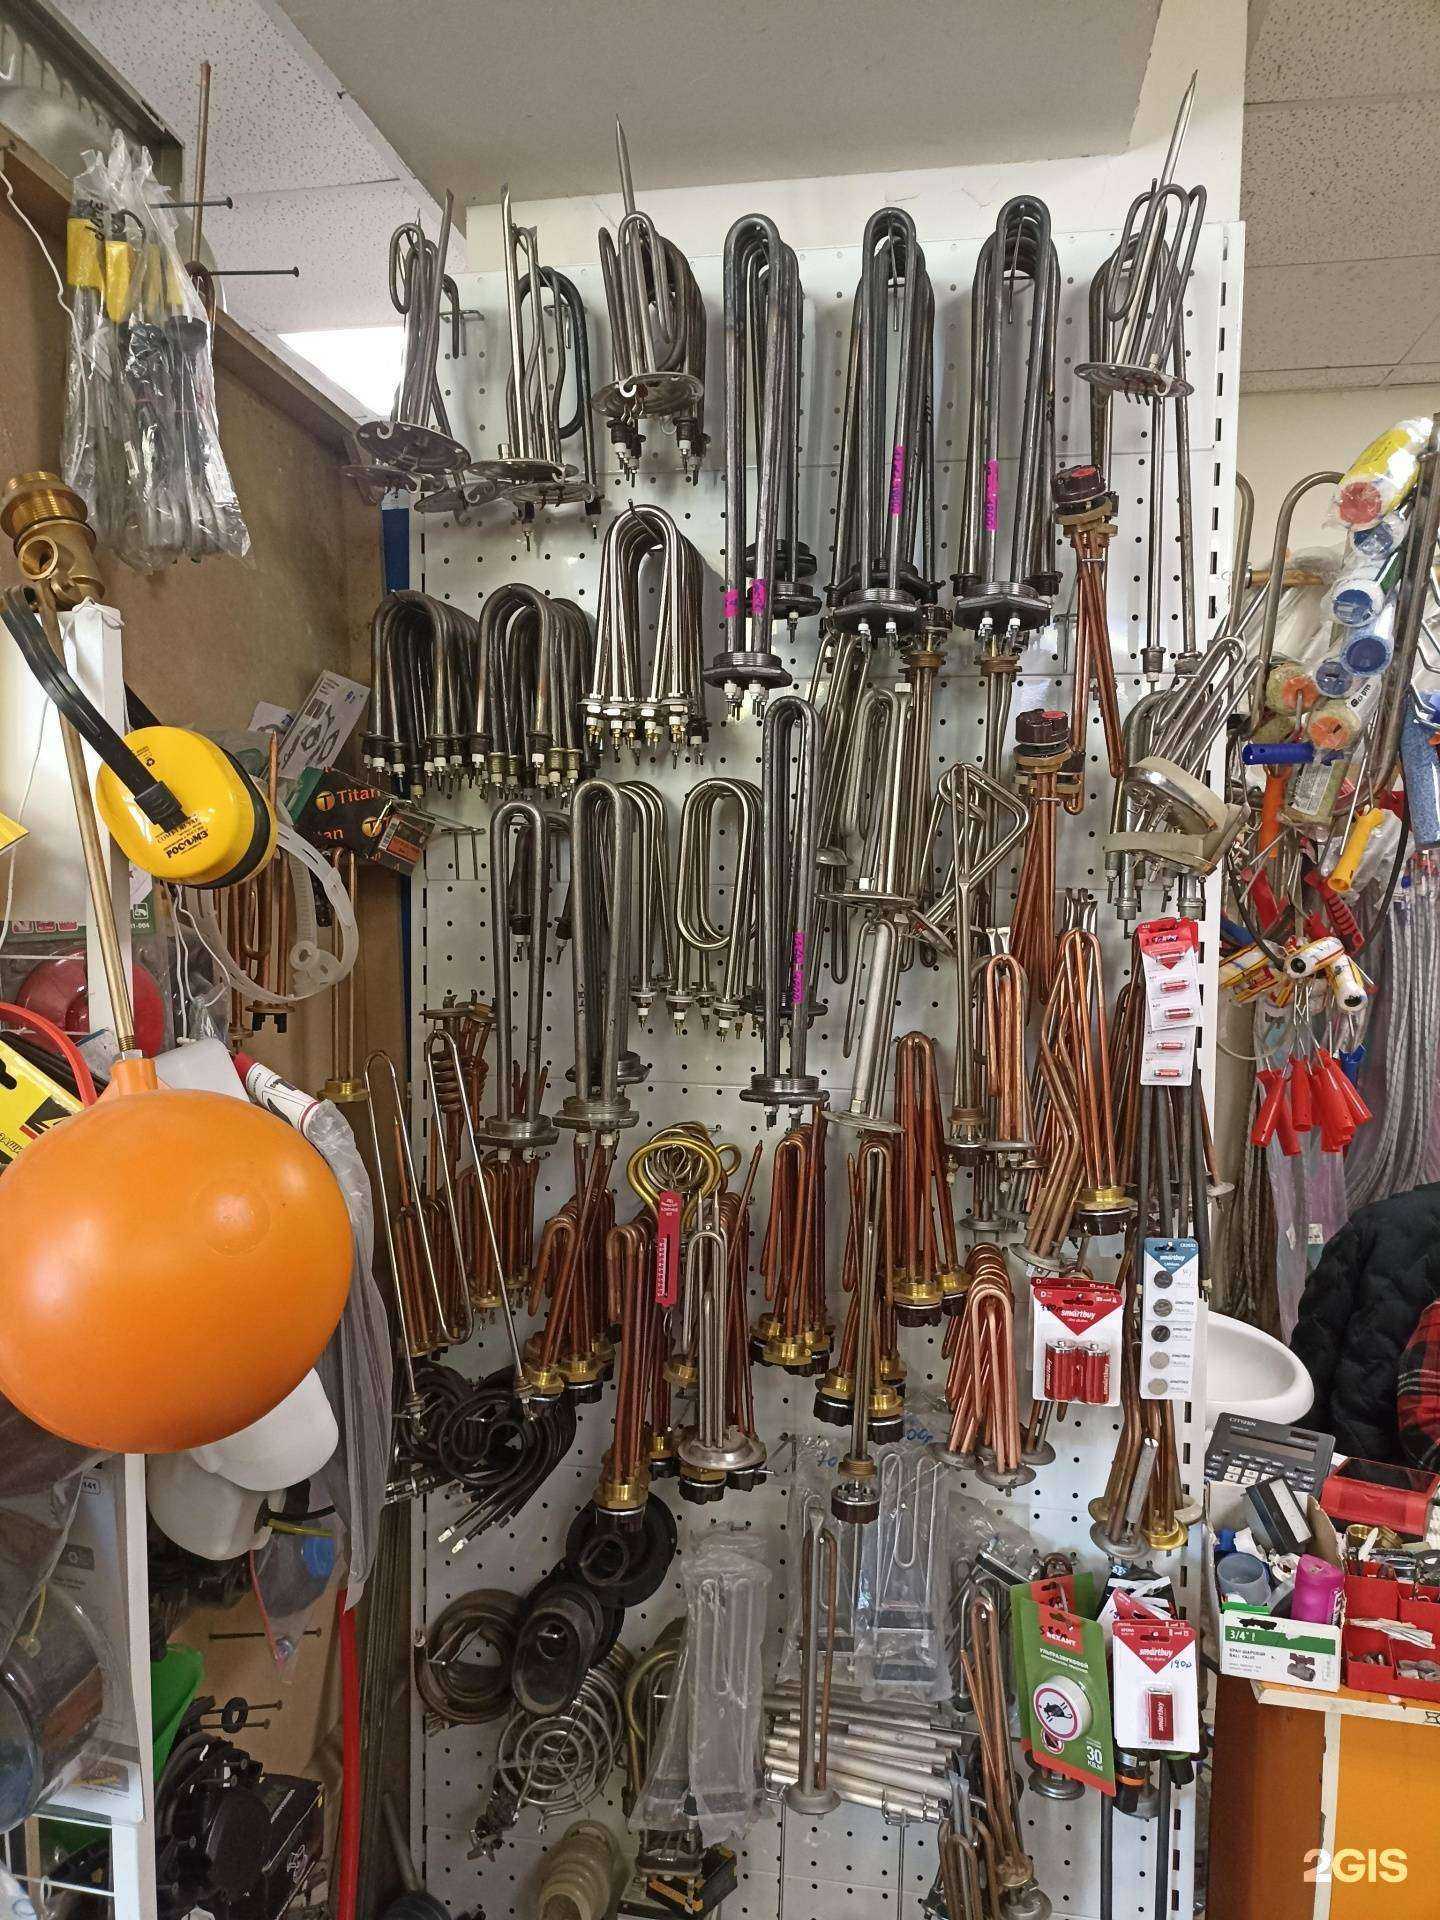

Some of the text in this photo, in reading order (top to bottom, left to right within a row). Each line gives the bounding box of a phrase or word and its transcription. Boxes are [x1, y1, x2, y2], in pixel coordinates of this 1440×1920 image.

[337, 788, 380, 804] Titan
[1060, 1308, 1096, 1320] smartbuy
[1139, 1648, 1173, 1658] smartbuy
[1157, 1701, 1165, 1732] smartbuy
[1086, 1746, 1103, 1765] 30
